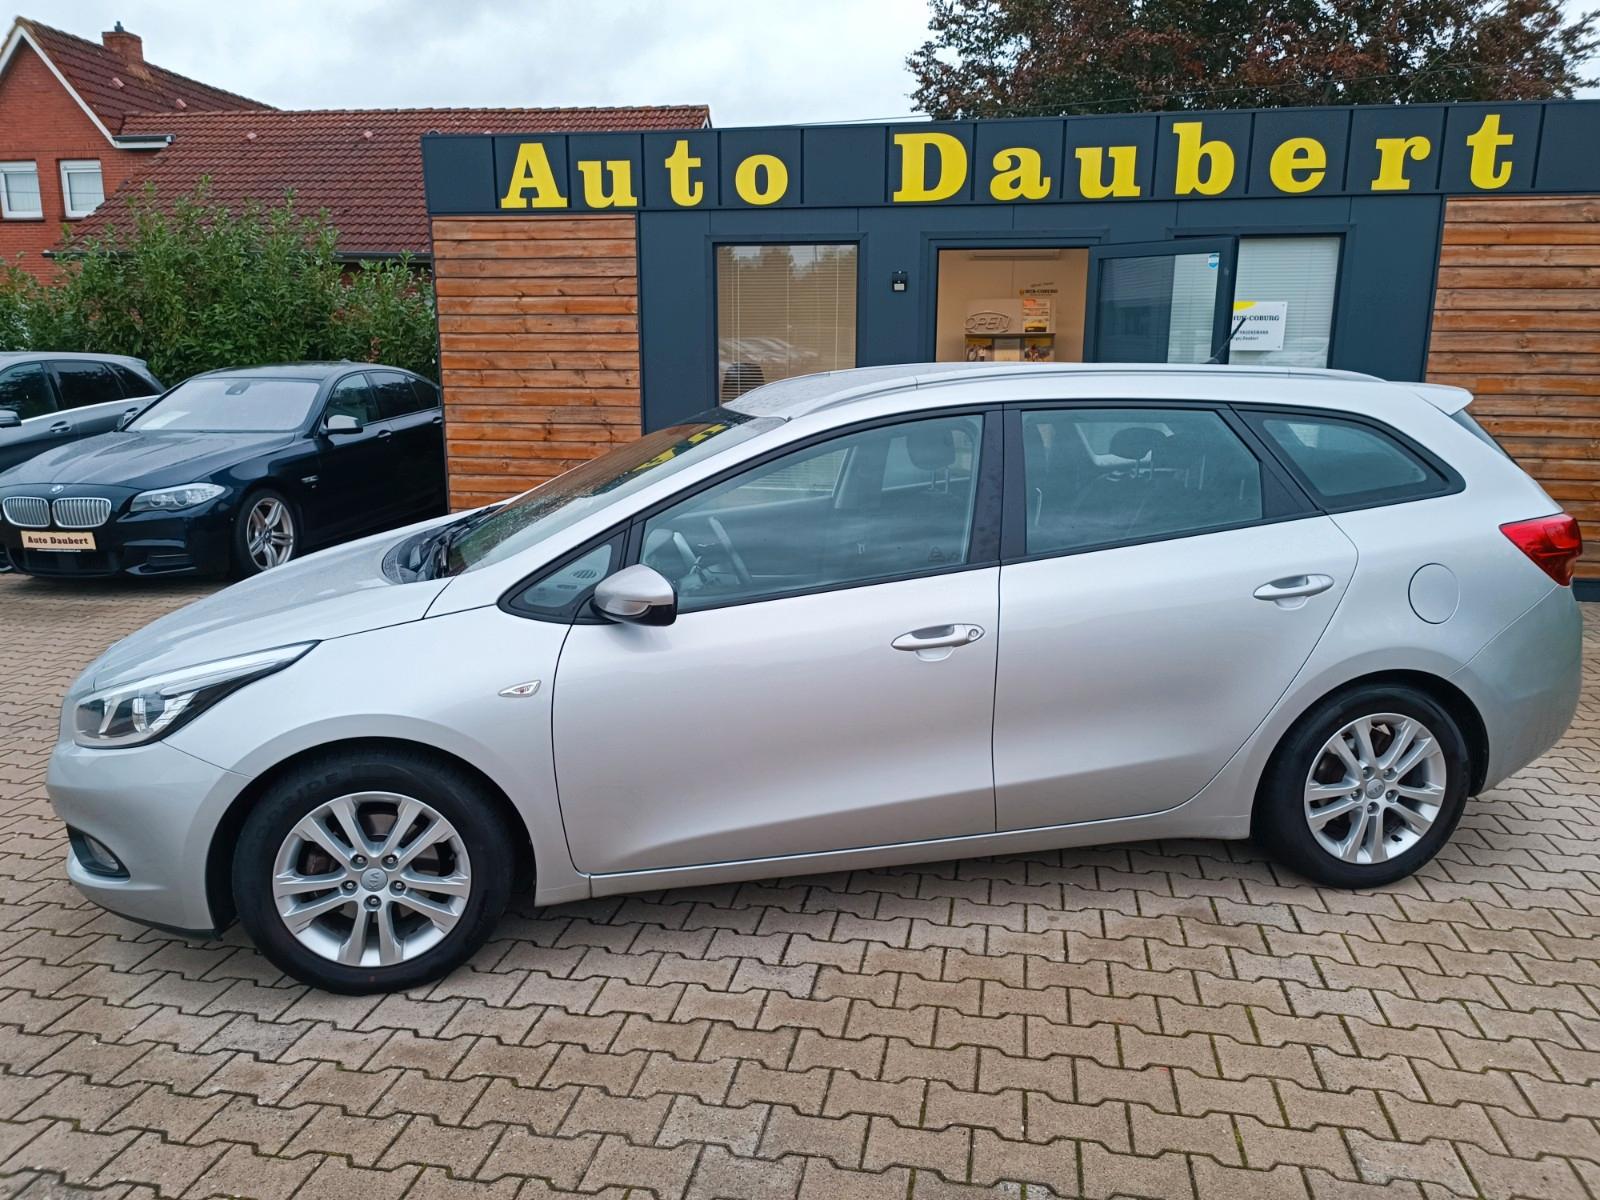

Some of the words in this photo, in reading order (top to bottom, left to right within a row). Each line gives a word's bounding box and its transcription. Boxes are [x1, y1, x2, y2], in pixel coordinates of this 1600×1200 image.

[501, 140, 788, 209] Auto
[893, 114, 1514, 202] Daubert
[27, 535, 48, 544] Auto
[50, 536, 89, 545] Daubert
